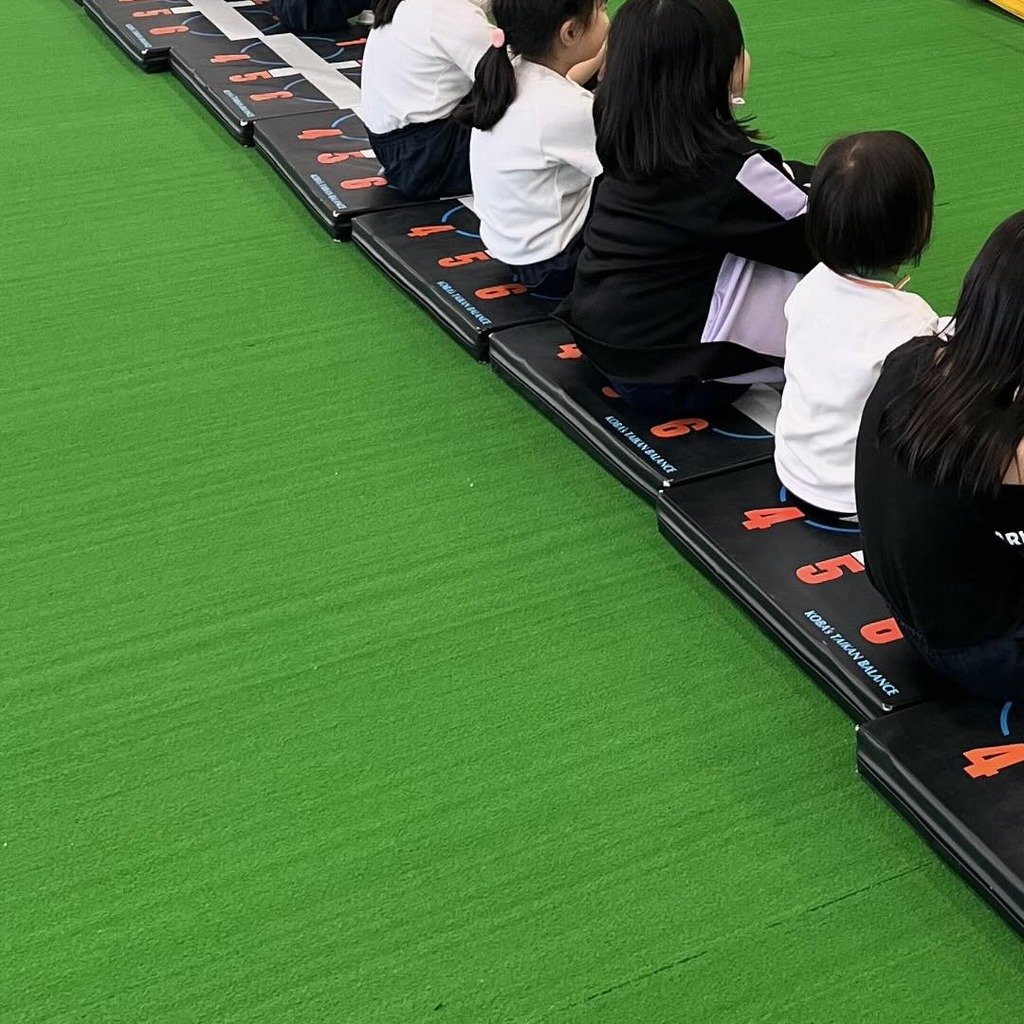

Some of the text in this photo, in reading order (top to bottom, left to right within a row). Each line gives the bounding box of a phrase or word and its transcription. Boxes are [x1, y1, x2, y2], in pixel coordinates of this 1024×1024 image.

[340, 176, 388, 190] 6
[406, 224, 455, 239] 4
[438, 250, 493, 269] 5
[474, 282, 528, 301] 6
[650, 417, 710, 438] 6
[742, 506, 806, 531] 4
[796, 554, 866, 585] 5
[830, 633, 865, 661] TAIKAN
[857, 659, 900, 696] BALANCE
